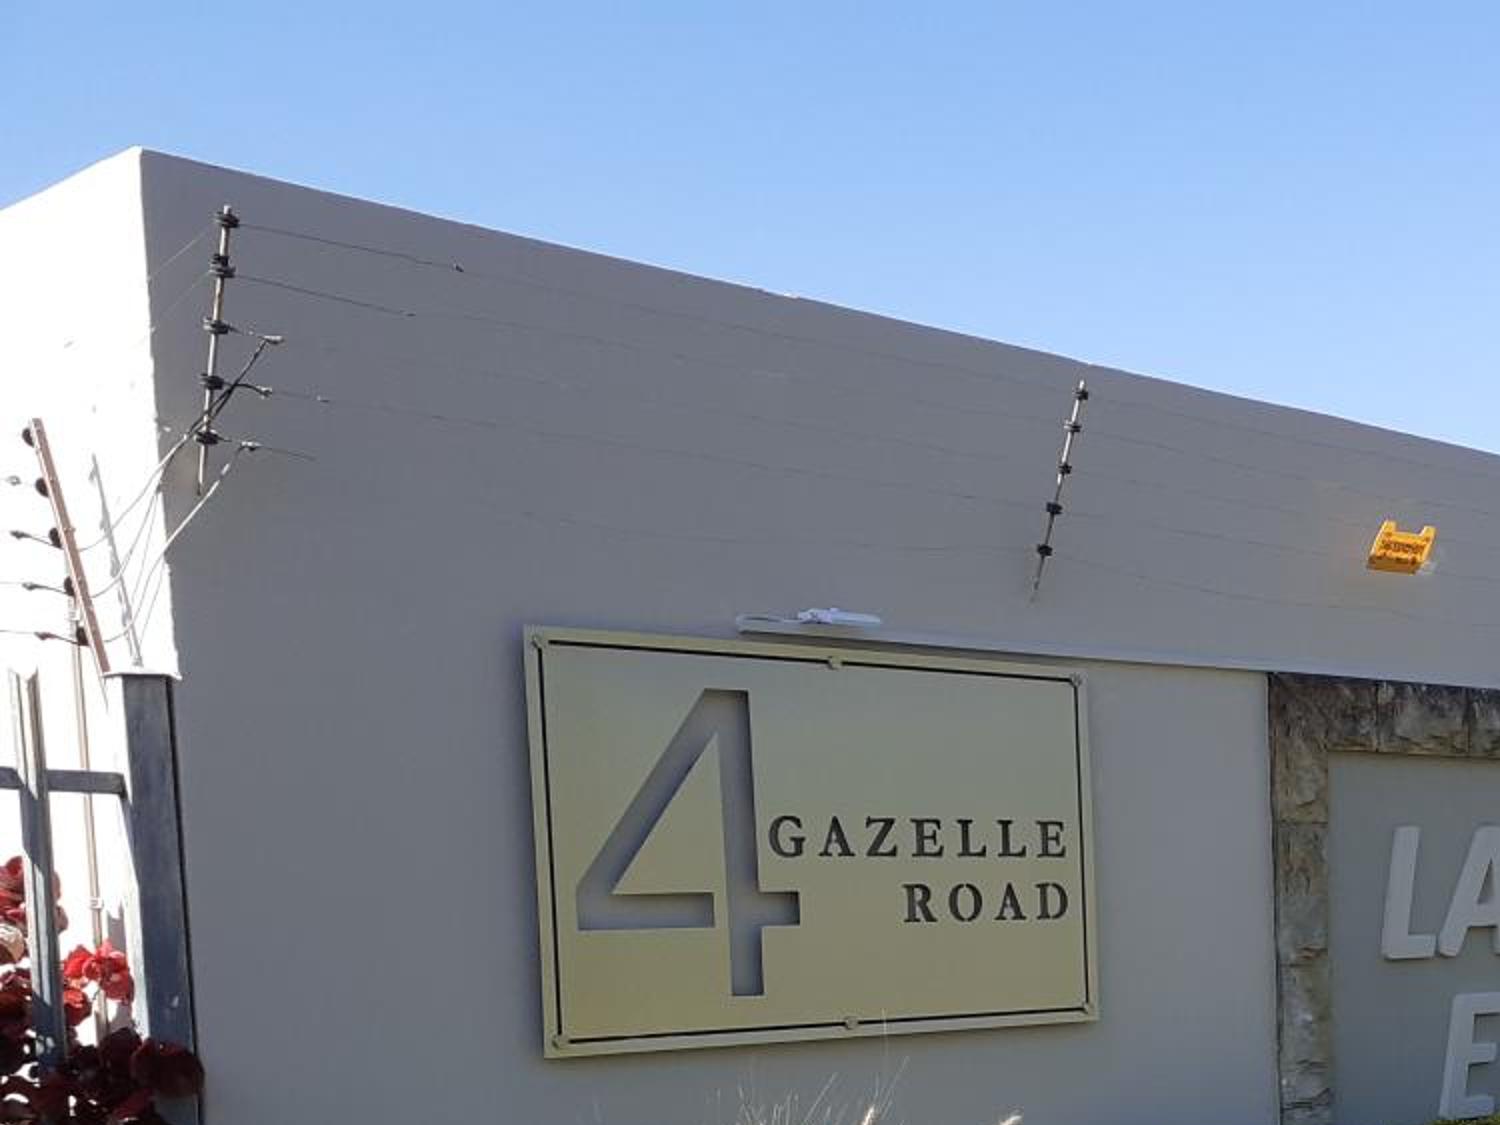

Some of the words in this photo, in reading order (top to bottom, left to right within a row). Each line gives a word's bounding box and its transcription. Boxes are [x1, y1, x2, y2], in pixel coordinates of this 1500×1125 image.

[575, 687, 800, 997] 4
[768, 815, 1066, 858] GAZELLE
[902, 883, 1069, 923] ROAD
